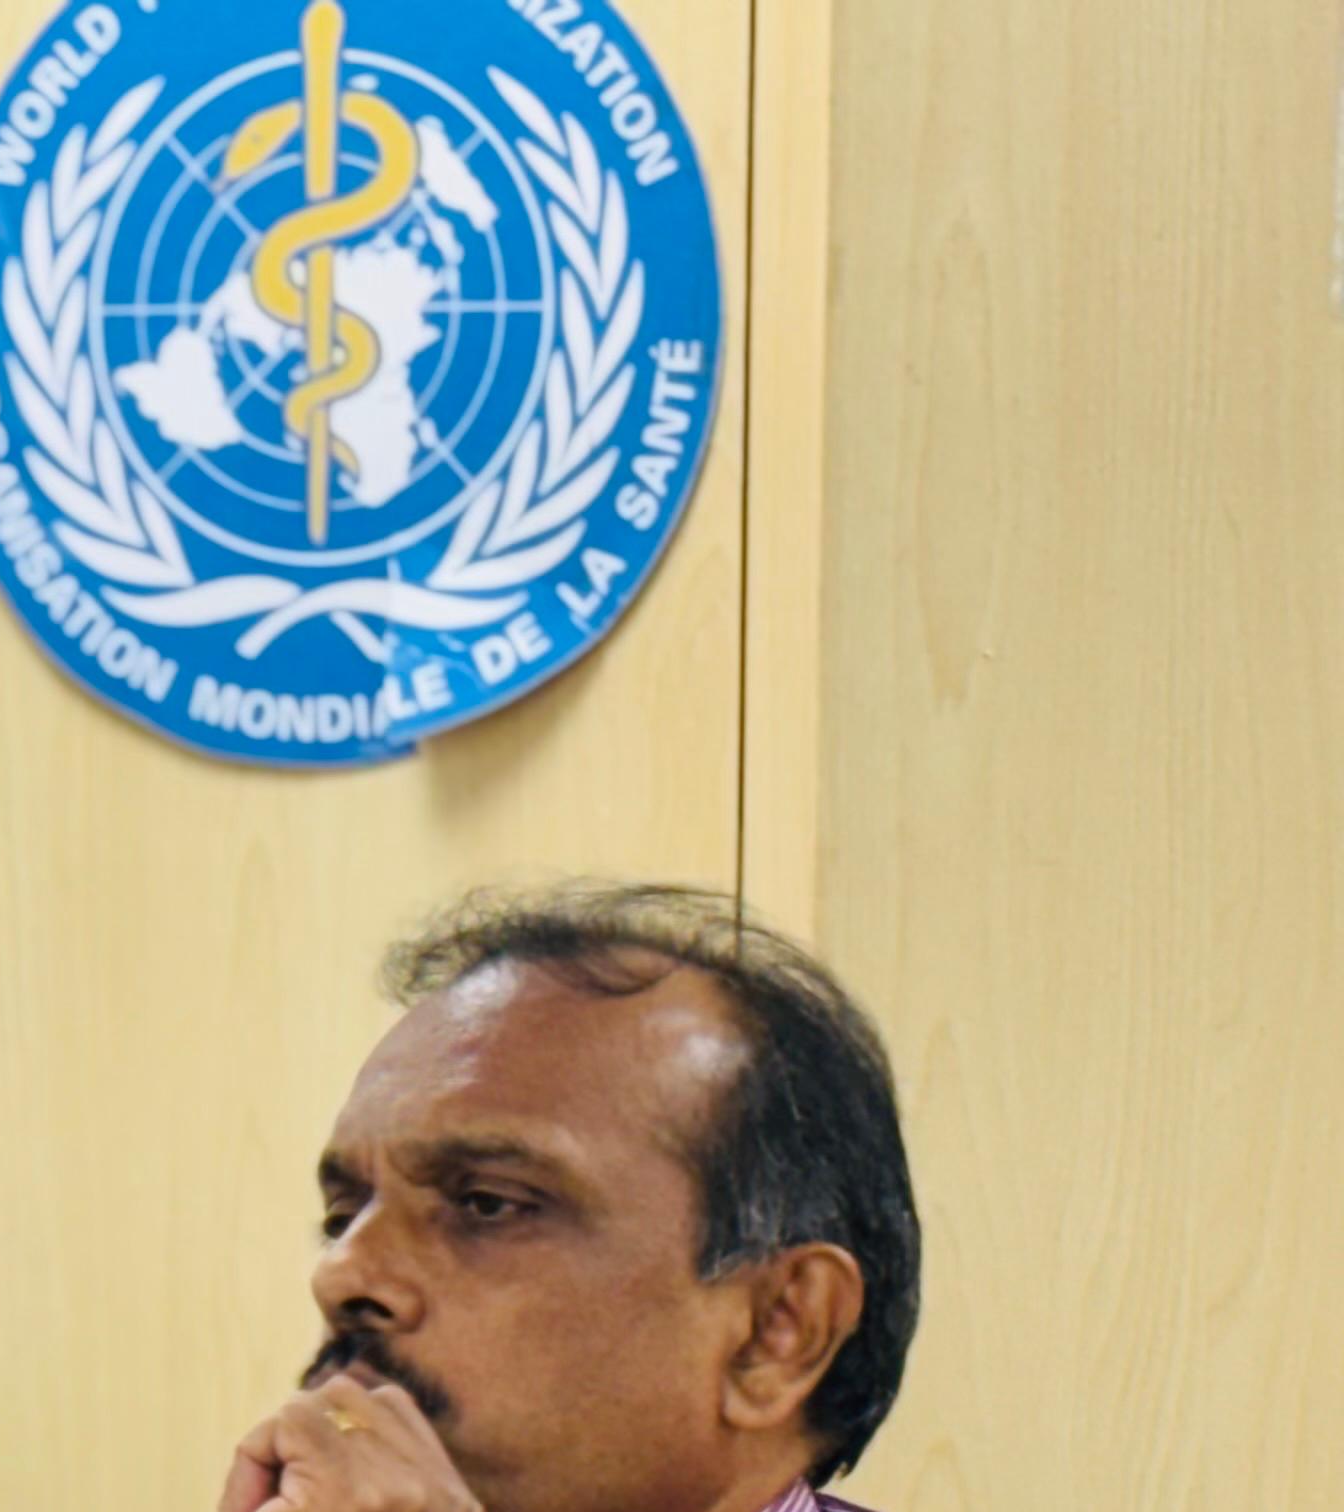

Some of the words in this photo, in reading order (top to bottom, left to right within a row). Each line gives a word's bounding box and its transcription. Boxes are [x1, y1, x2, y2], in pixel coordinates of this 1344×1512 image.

[506, 0, 680, 187] IZATION
[469, 609, 554, 687] DE
[555, 546, 628, 621] LA
[615, 337, 703, 531] SANTÉ
